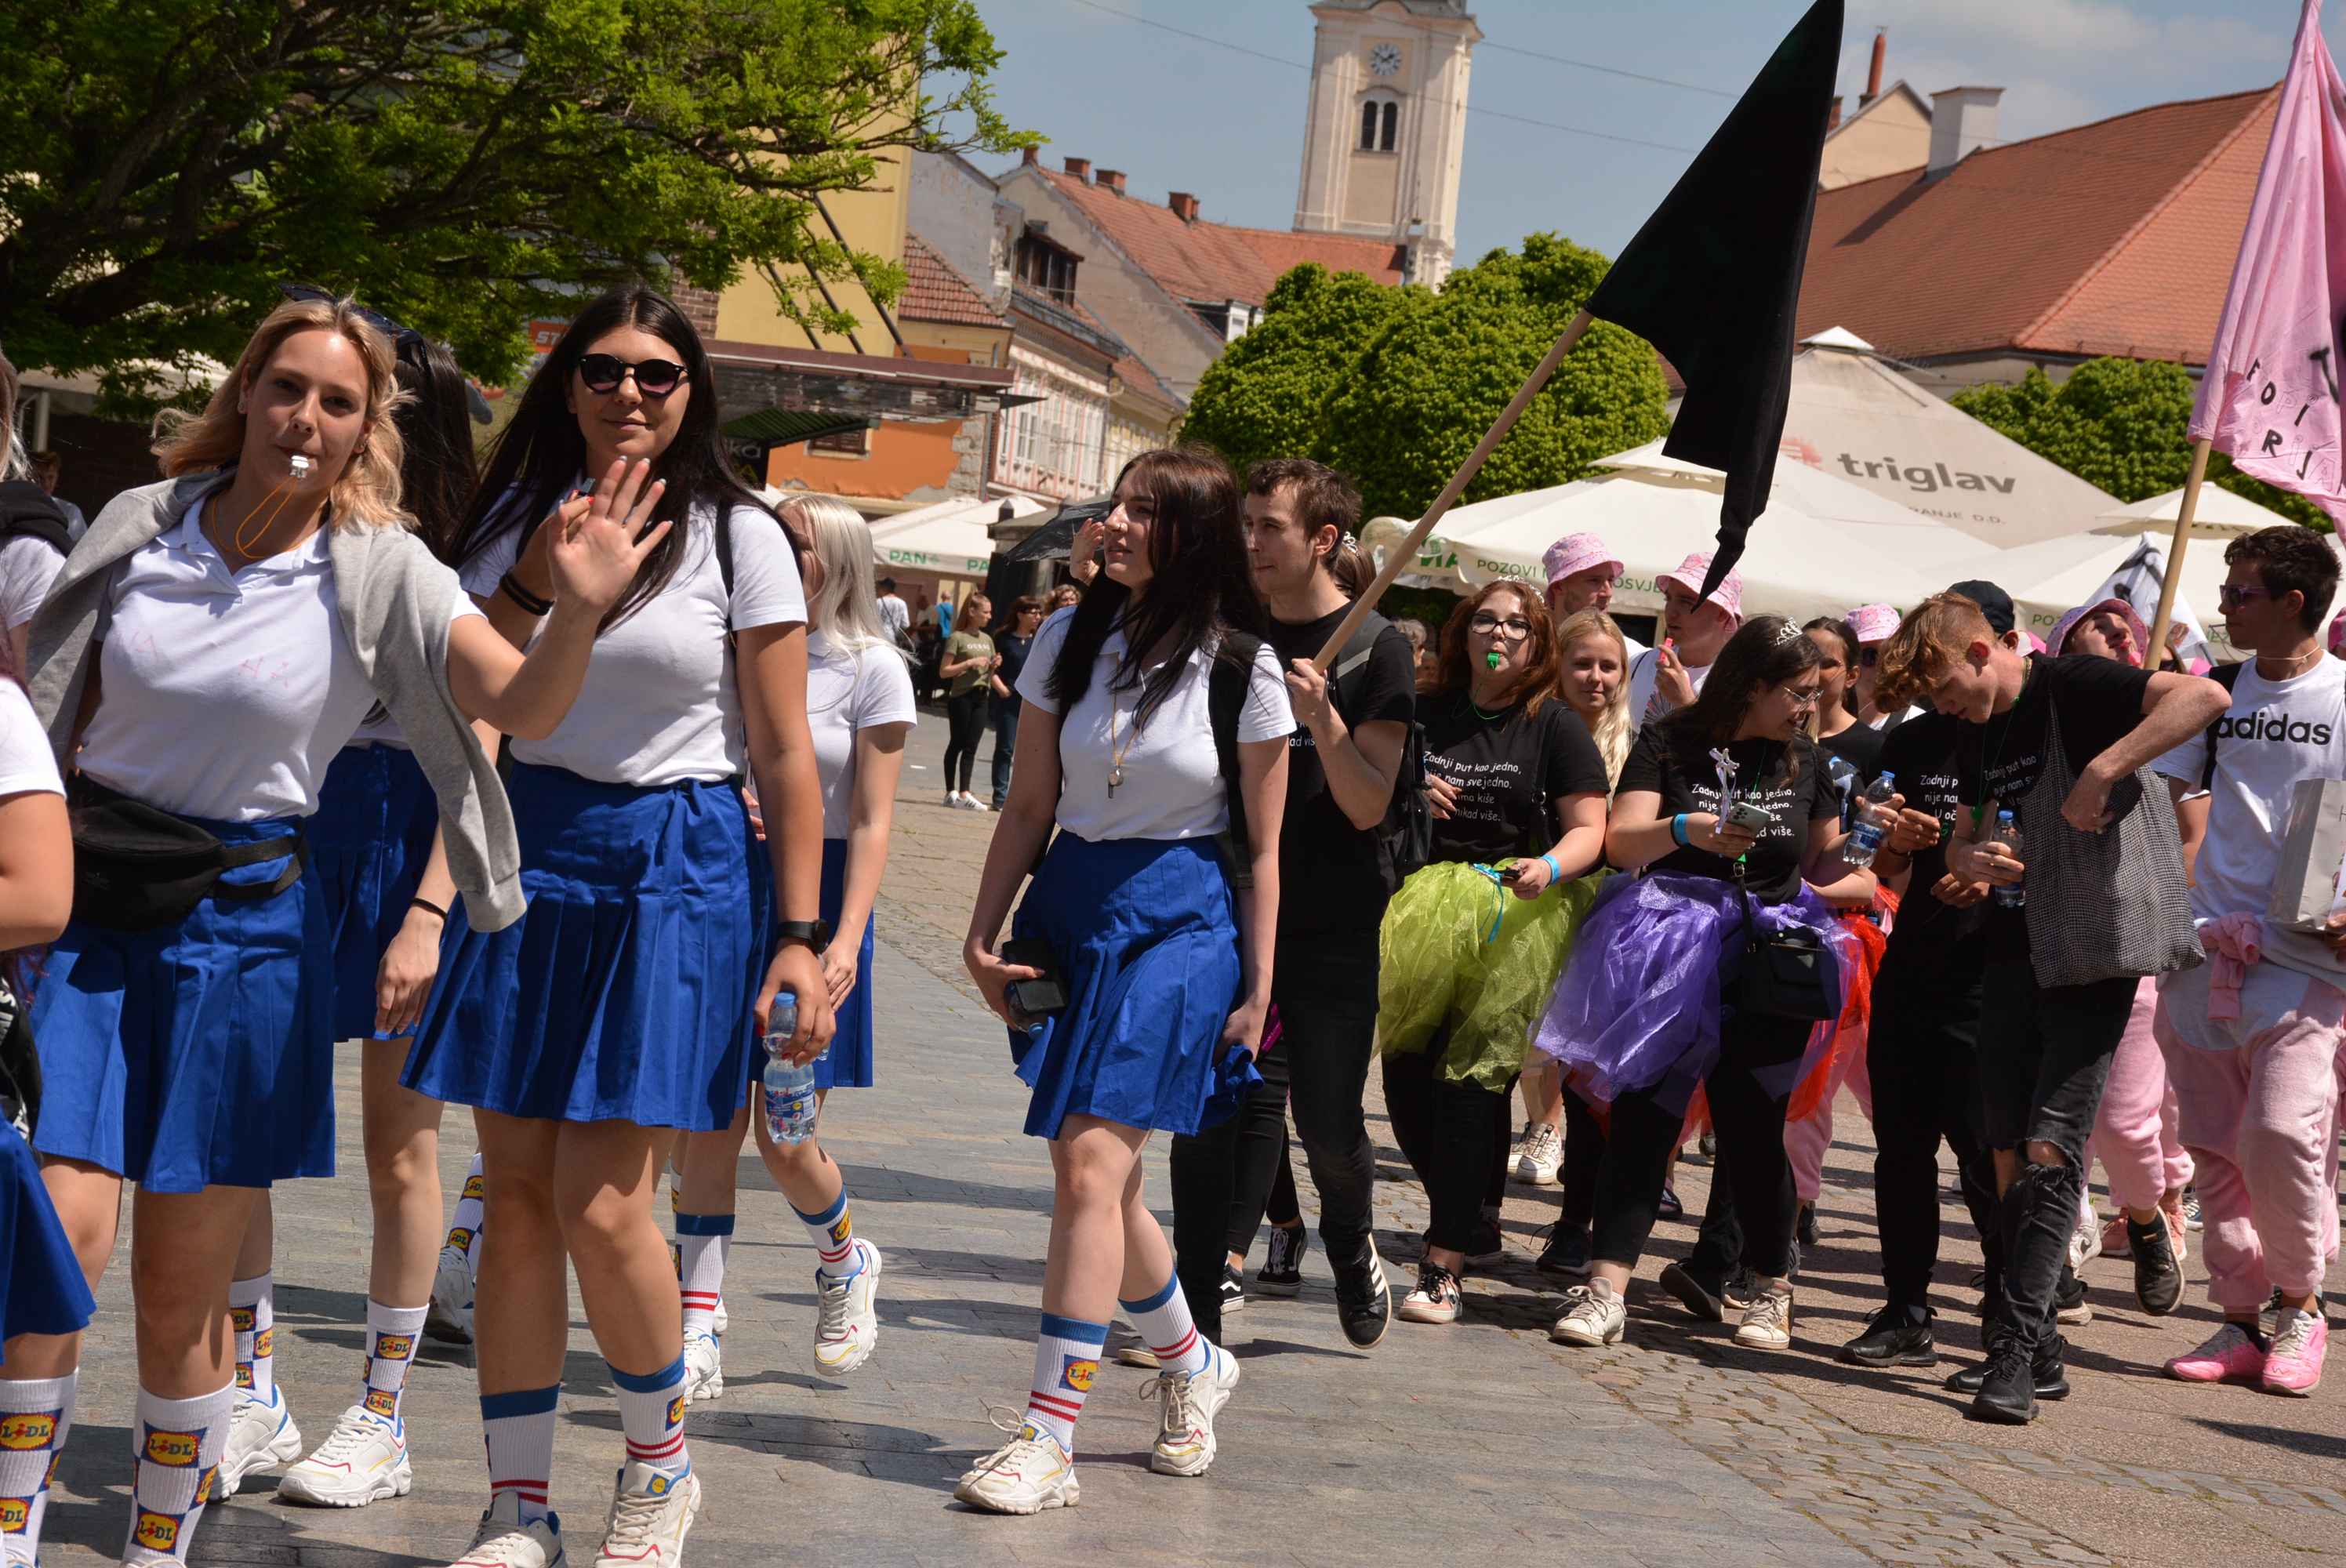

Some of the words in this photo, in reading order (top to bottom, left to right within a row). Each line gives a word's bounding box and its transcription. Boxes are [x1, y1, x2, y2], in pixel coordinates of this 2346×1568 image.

[1837, 453, 2016, 493] triglav
[890, 551, 926, 564] PAN
[967, 559, 989, 572] PA
[1477, 559, 1537, 578] POZOVI
[2217, 712, 2331, 745] adidas
[1423, 751, 1454, 769] Zadnji
[1454, 762, 1472, 772] put
[1475, 764, 1489, 772] kao
[1491, 761, 1522, 775] jedno,
[2021, 755, 2037, 767] kao
[1445, 775, 1465, 786] nam
[1921, 775, 1949, 789] Zadnji
[1925, 793, 1941, 804] nije
